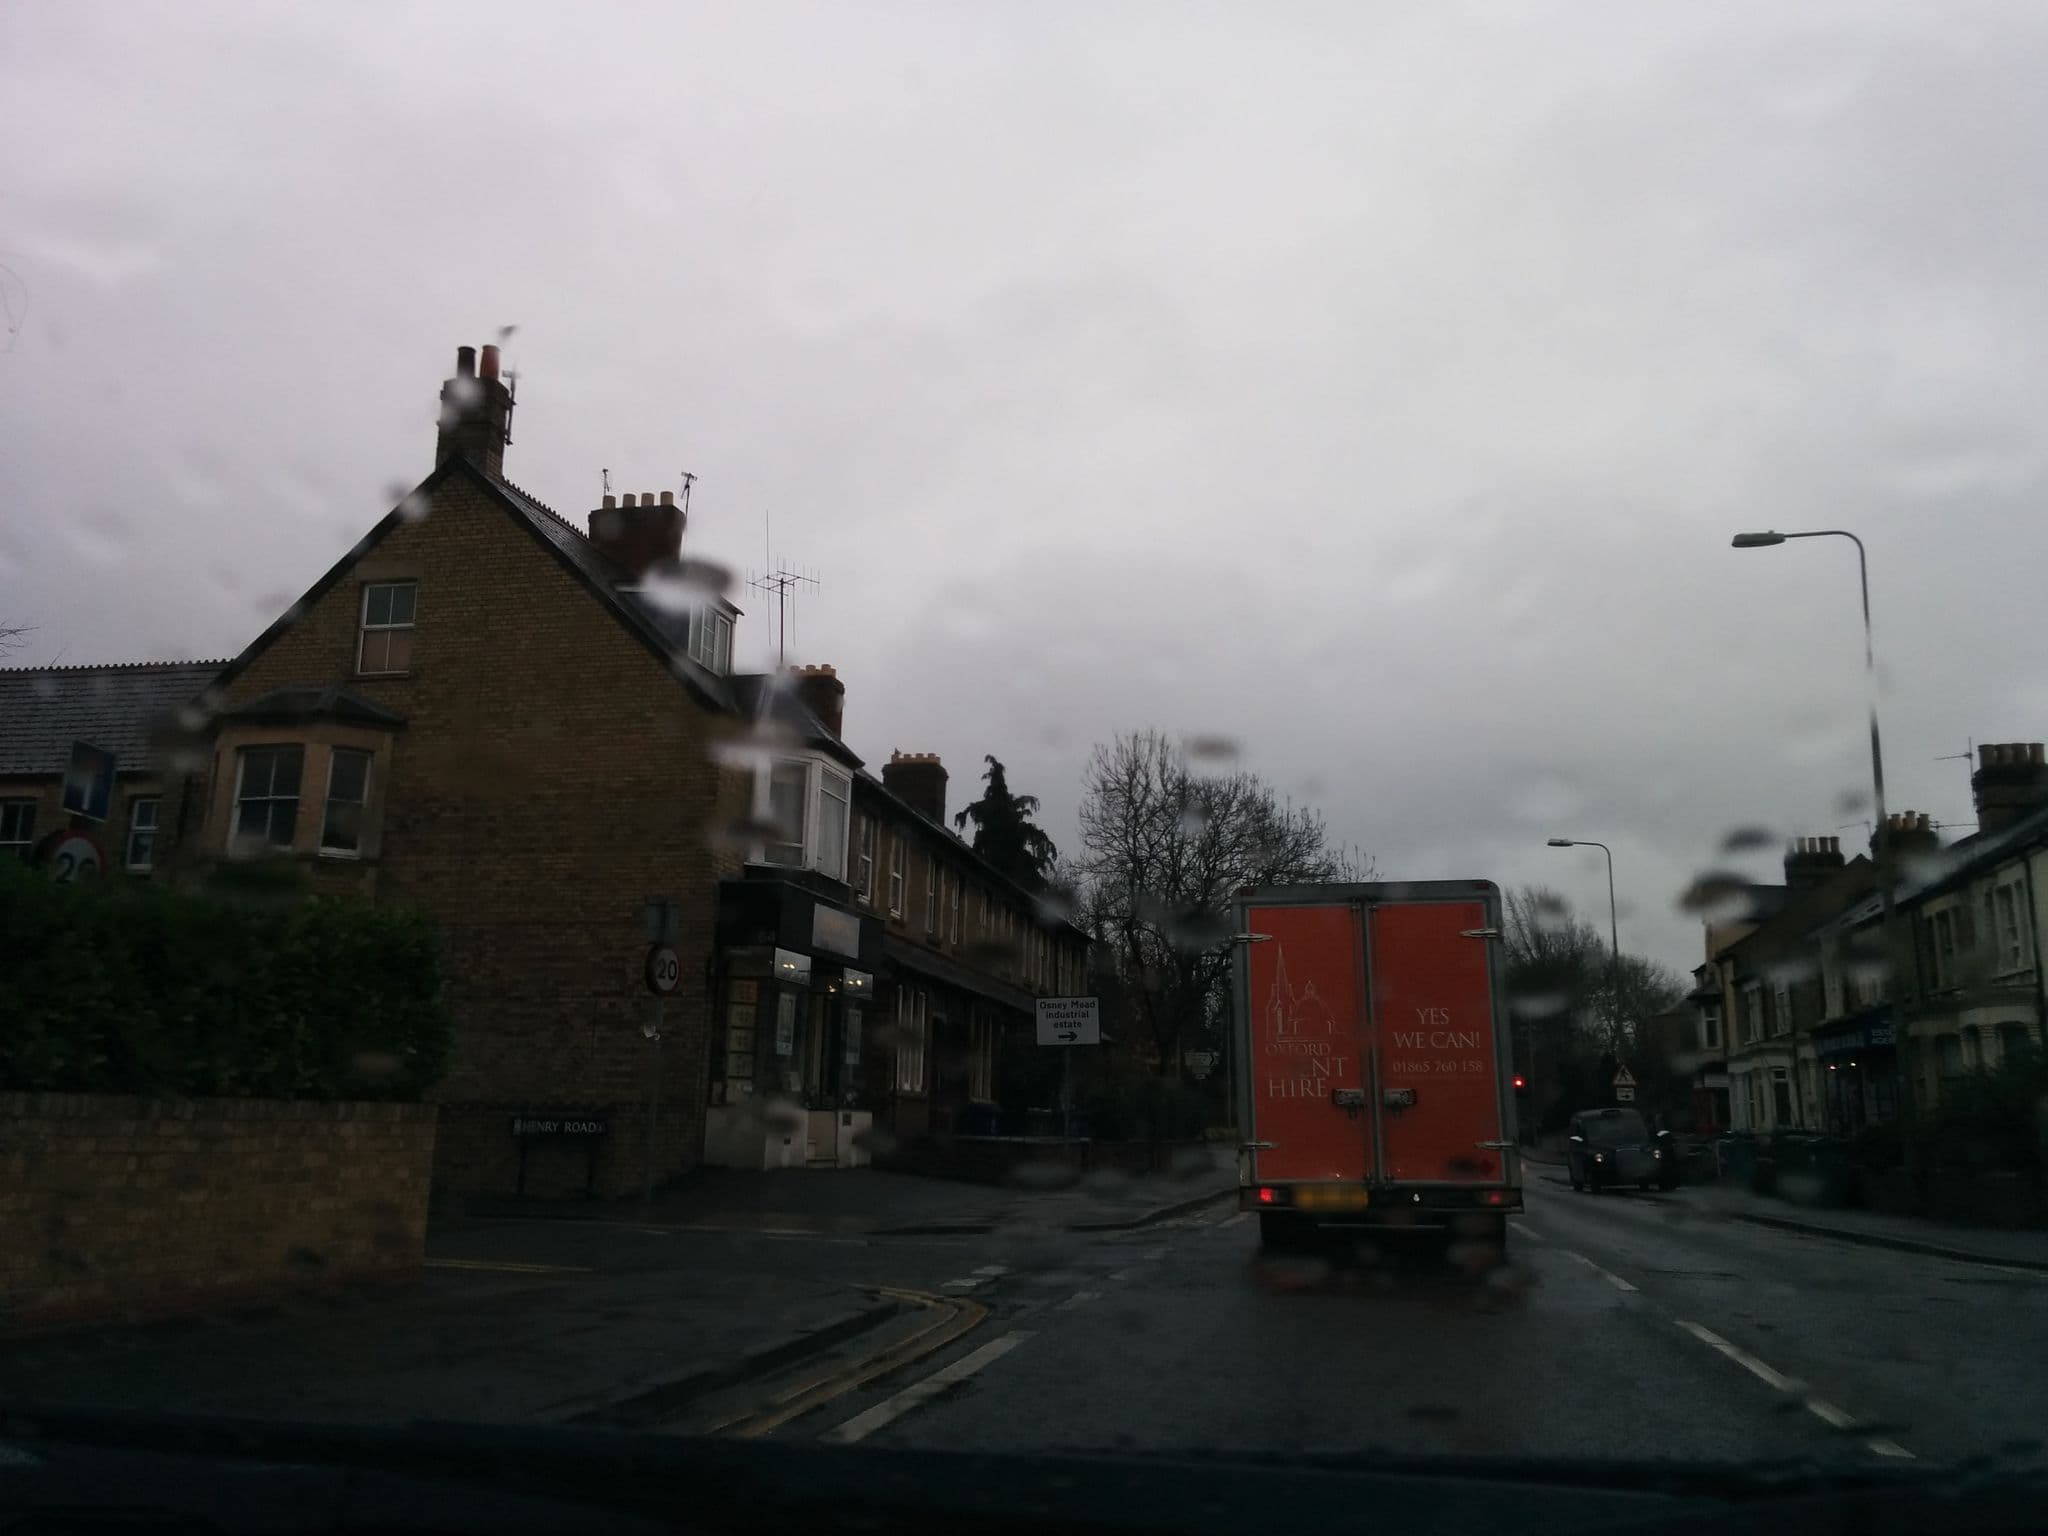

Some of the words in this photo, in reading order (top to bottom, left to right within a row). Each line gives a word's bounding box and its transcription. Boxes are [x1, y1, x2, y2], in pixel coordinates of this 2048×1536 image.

[56, 852, 96, 884] 2
[658, 958, 677, 980] 20
[1040, 1001, 1067, 1009] Osney
[1071, 1001, 1096, 1009] Mead
[1047, 1010, 1089, 1019] industrial
[1416, 1007, 1449, 1025] YES
[1392, 1031, 1425, 1049] WE
[1430, 1031, 1480, 1049] CAN!
[1393, 1060, 1430, 1073] 01865
[1434, 1060, 1457, 1073] 760
[1268, 1079, 1328, 1098] HIRE
[564, 1120, 597, 1133] ROAD
